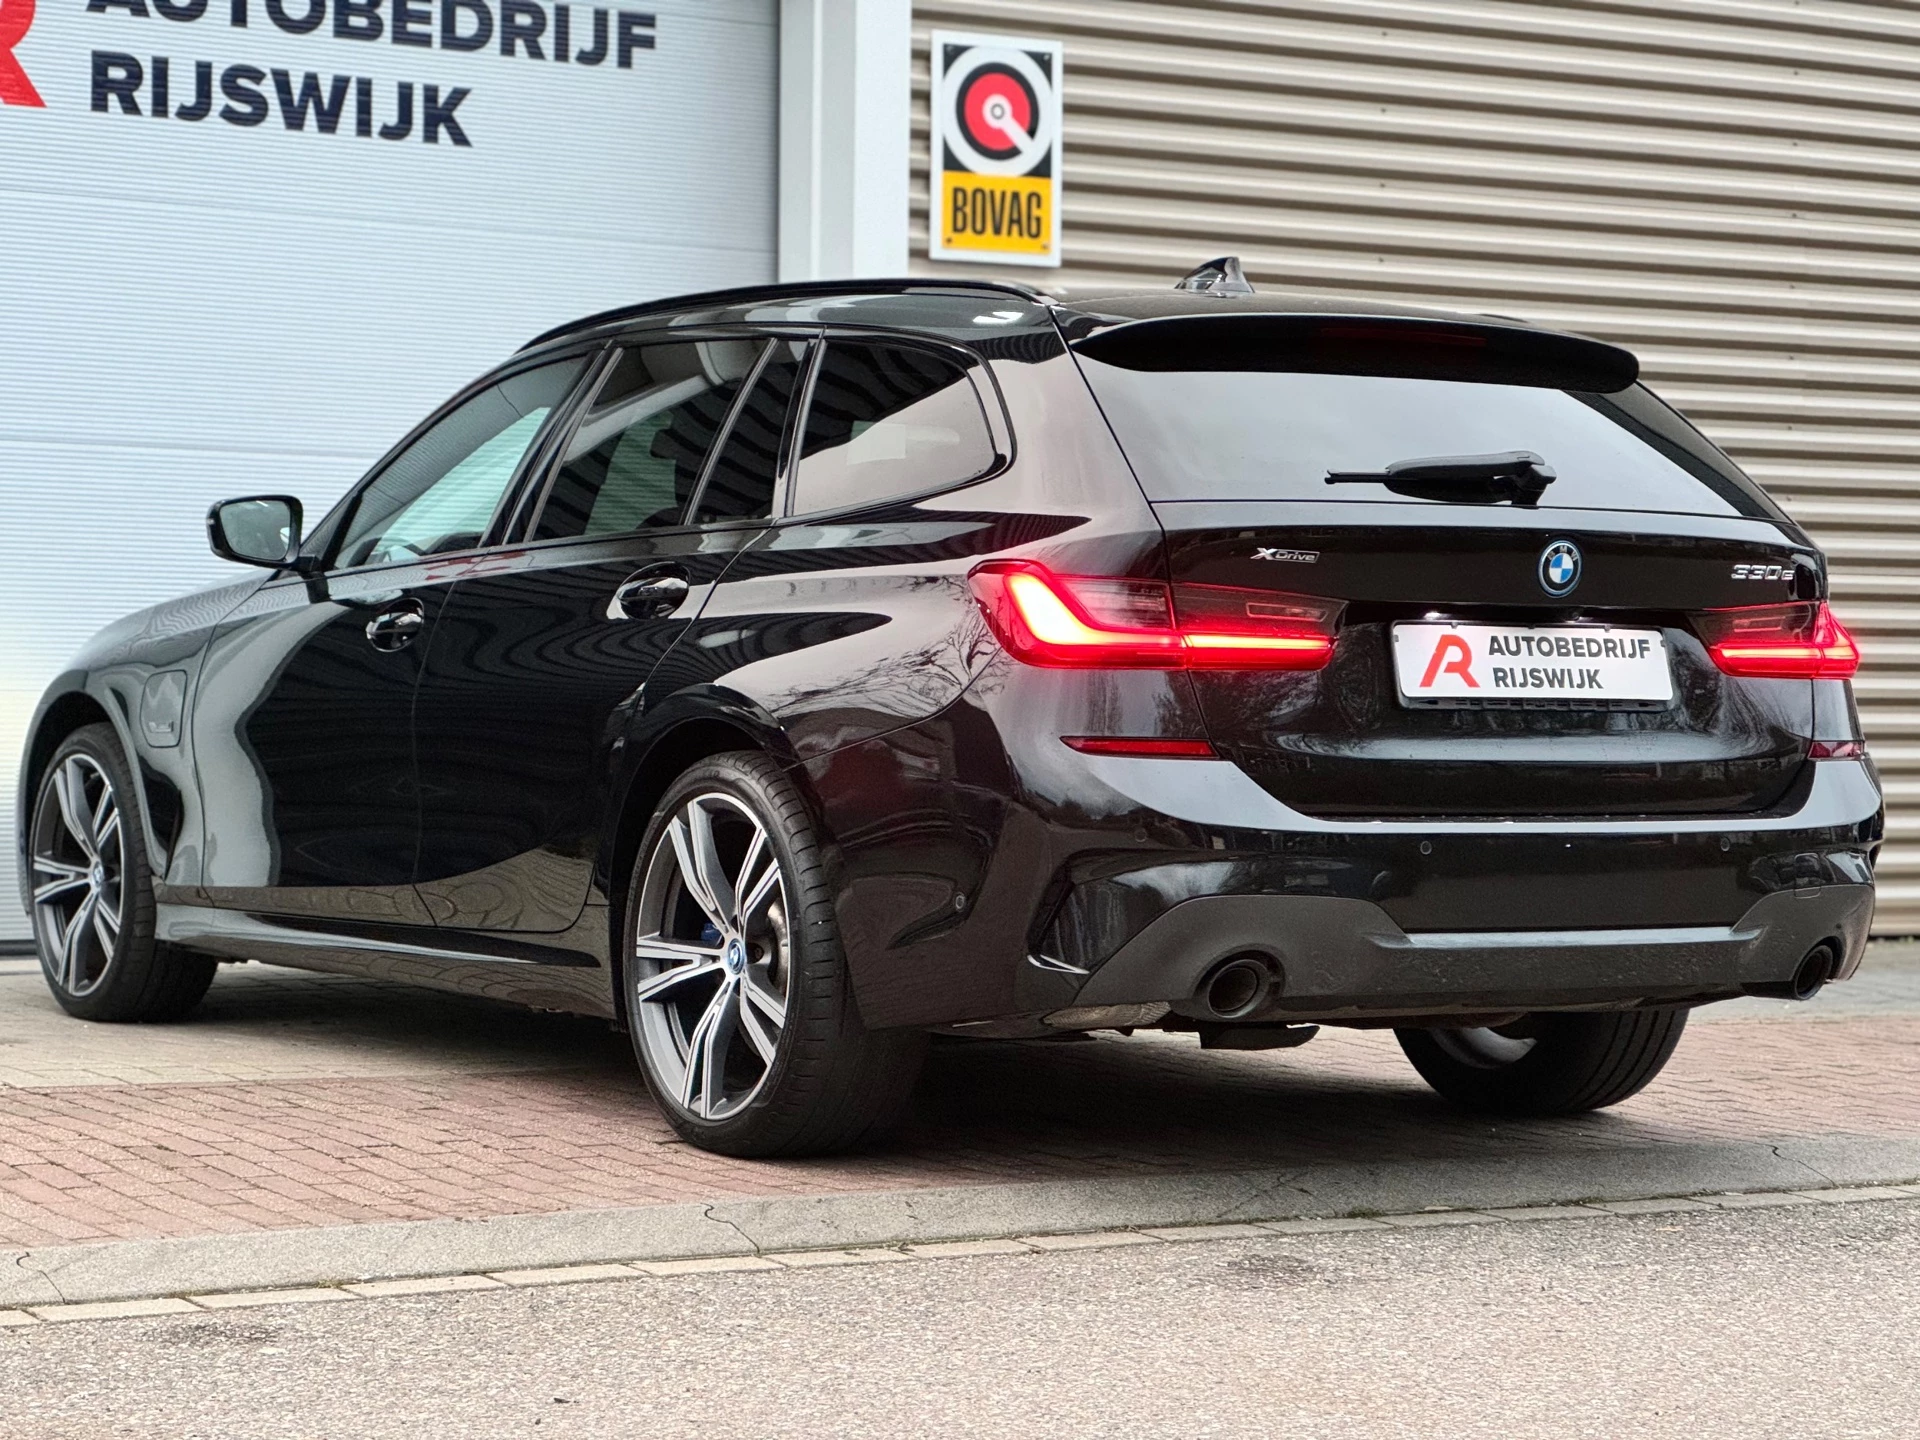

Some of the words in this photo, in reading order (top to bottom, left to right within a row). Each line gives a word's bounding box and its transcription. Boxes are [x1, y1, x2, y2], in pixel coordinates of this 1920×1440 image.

[86, 0, 656, 69] OBEDRIJF
[90, 50, 473, 147] RIJSWIJK
[952, 187, 1042, 239] BOVAG
[1731, 564, 1795, 580] 330e
[1489, 635, 1650, 659] AUTOBEDRIJF
[1493, 667, 1604, 690] RIJSWIJK
